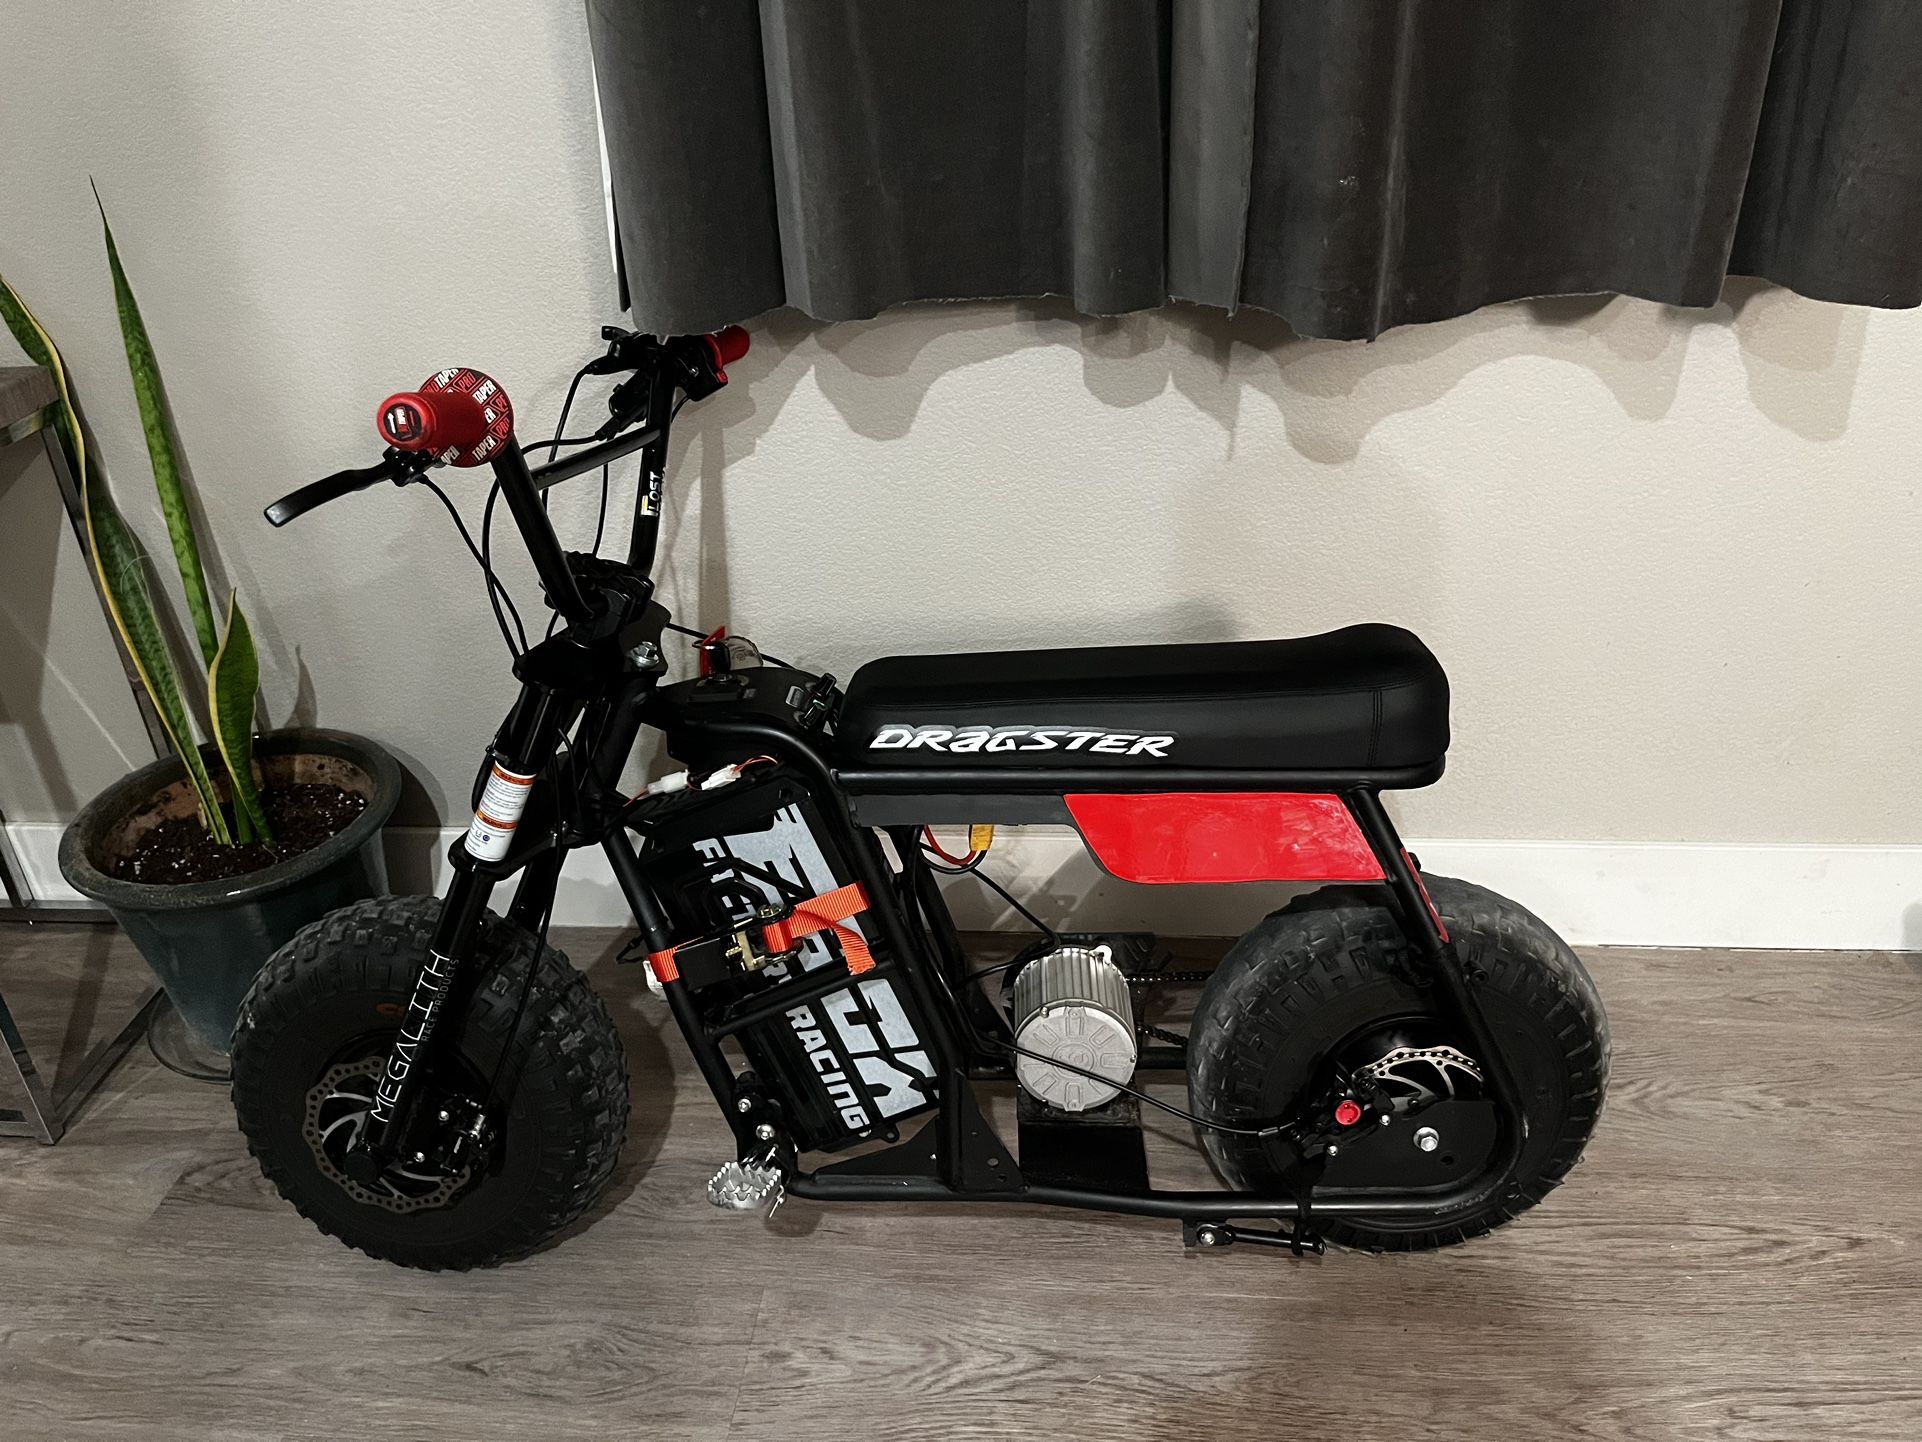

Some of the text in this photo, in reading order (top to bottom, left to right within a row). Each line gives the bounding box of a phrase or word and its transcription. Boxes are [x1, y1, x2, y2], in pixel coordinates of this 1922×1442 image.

[471, 435, 497, 461] TAPER
[431, 958, 460, 1013] PRODUCTS
[370, 949, 451, 1123] MEGALITH
[785, 1004, 871, 1130] RACING
